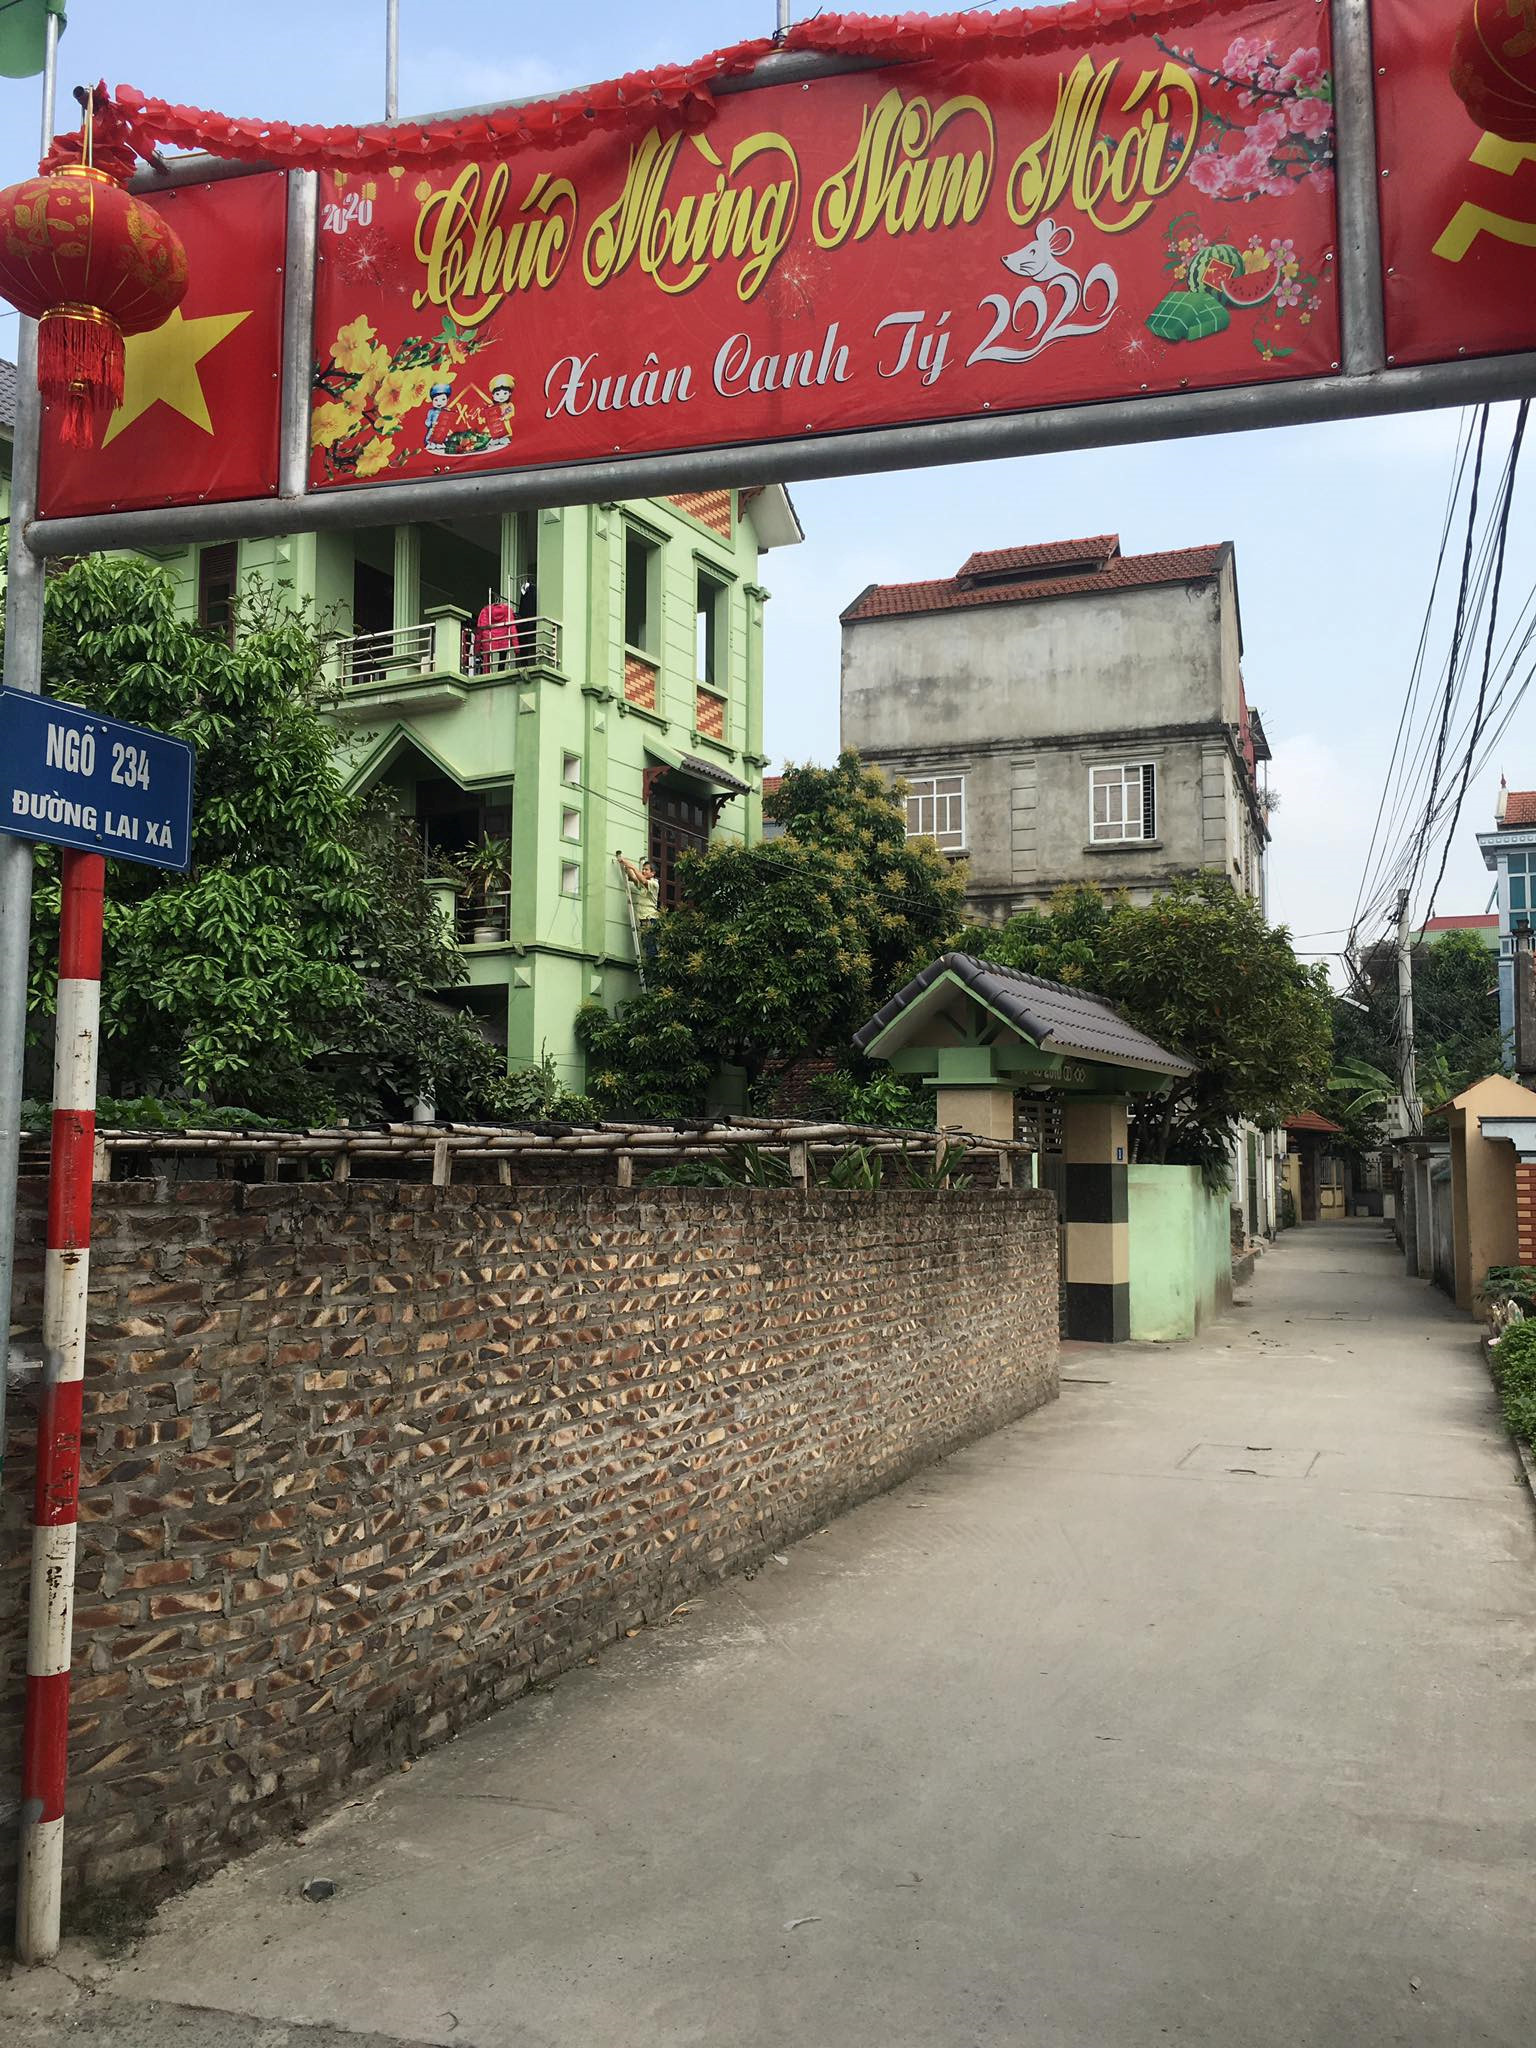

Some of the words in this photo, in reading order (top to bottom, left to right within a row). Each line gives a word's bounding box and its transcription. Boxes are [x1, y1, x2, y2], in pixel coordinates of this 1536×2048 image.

[322, 192, 373, 235] 2020
[412, 162, 577, 327] Chúc
[583, 127, 799, 302] Mừng
[812, 88, 995, 249] Năm
[1006, 53, 1199, 232] Mới
[545, 352, 697, 419] Xuân
[713, 321, 854, 398] Canh
[874, 310, 955, 386] Tý
[965, 262, 1122, 368] 2020
[46, 723, 96, 777] NGÕ
[111, 742, 150, 791] 234
[12, 789, 97, 832] ĐƯỜNG
[104, 811, 138, 841] LAI
[145, 820, 173, 849] XÁ
